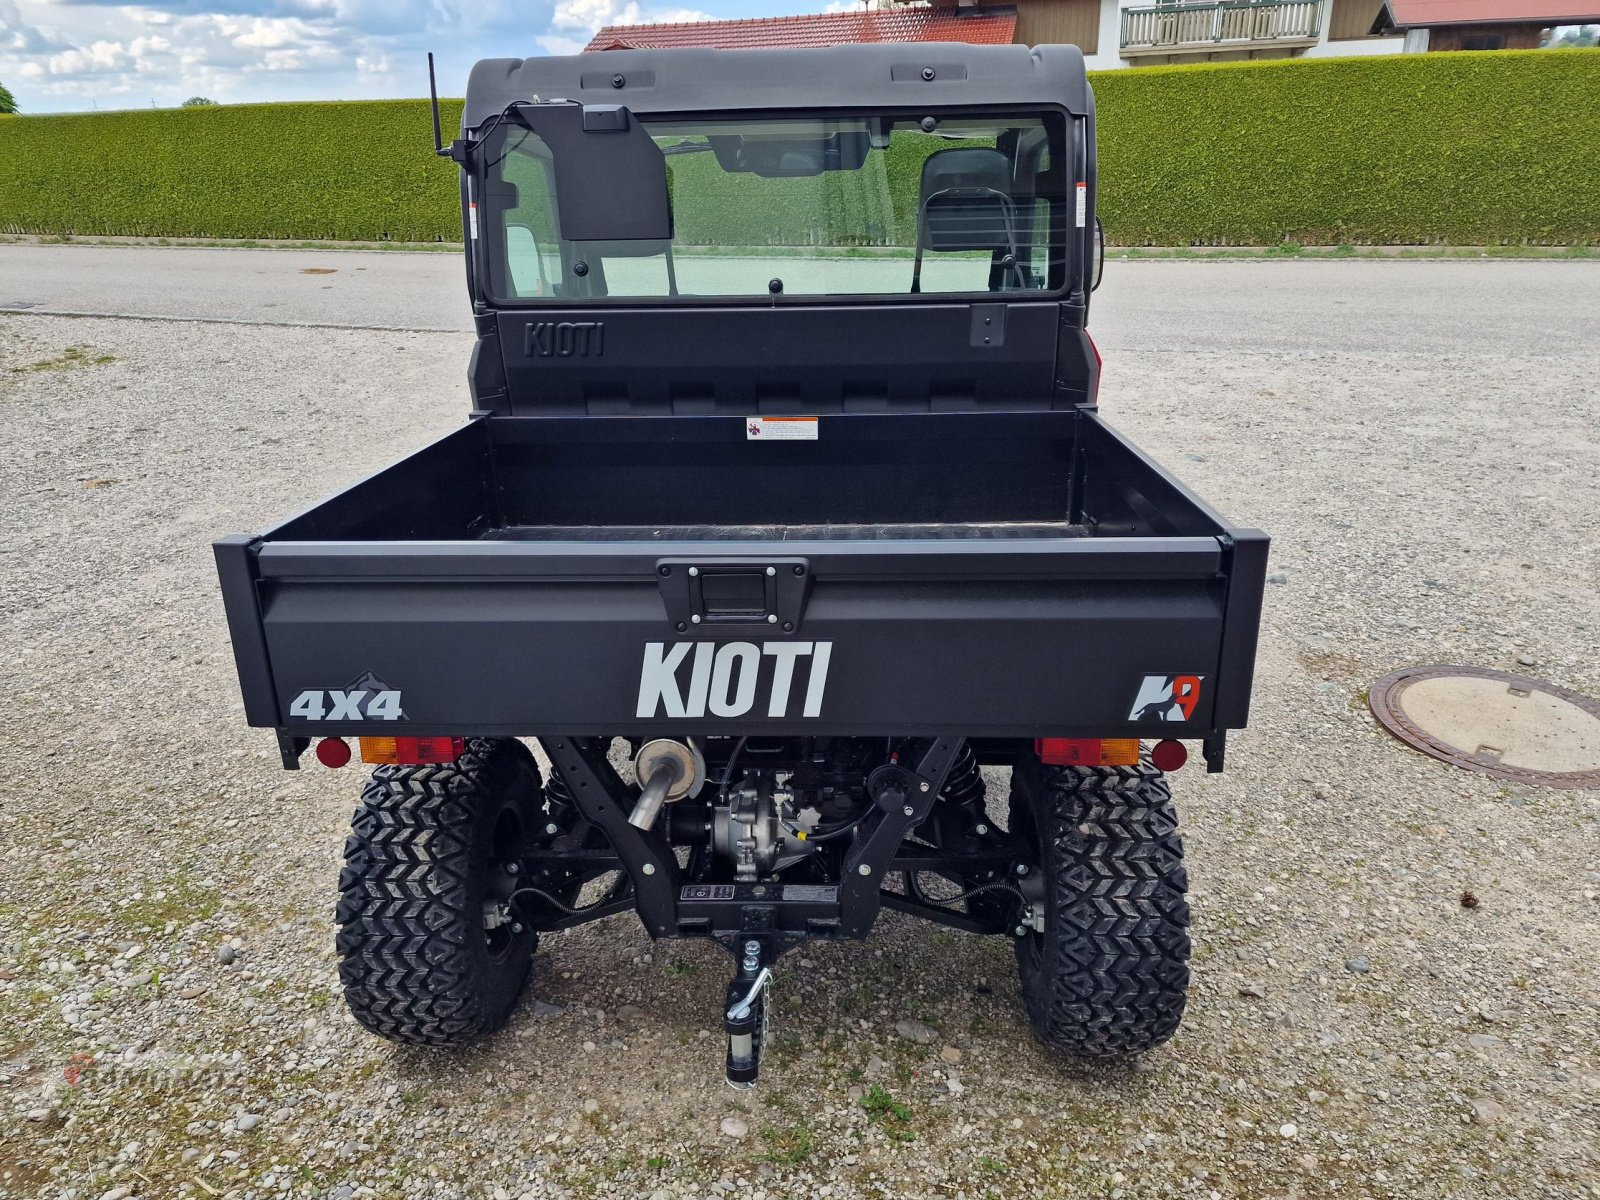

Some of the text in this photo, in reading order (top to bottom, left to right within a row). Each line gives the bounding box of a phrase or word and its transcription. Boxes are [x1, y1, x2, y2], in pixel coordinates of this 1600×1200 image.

[525, 322, 604, 357] KIOTI
[636, 641, 833, 718] KIOTI
[1128, 675, 1205, 721] K9
